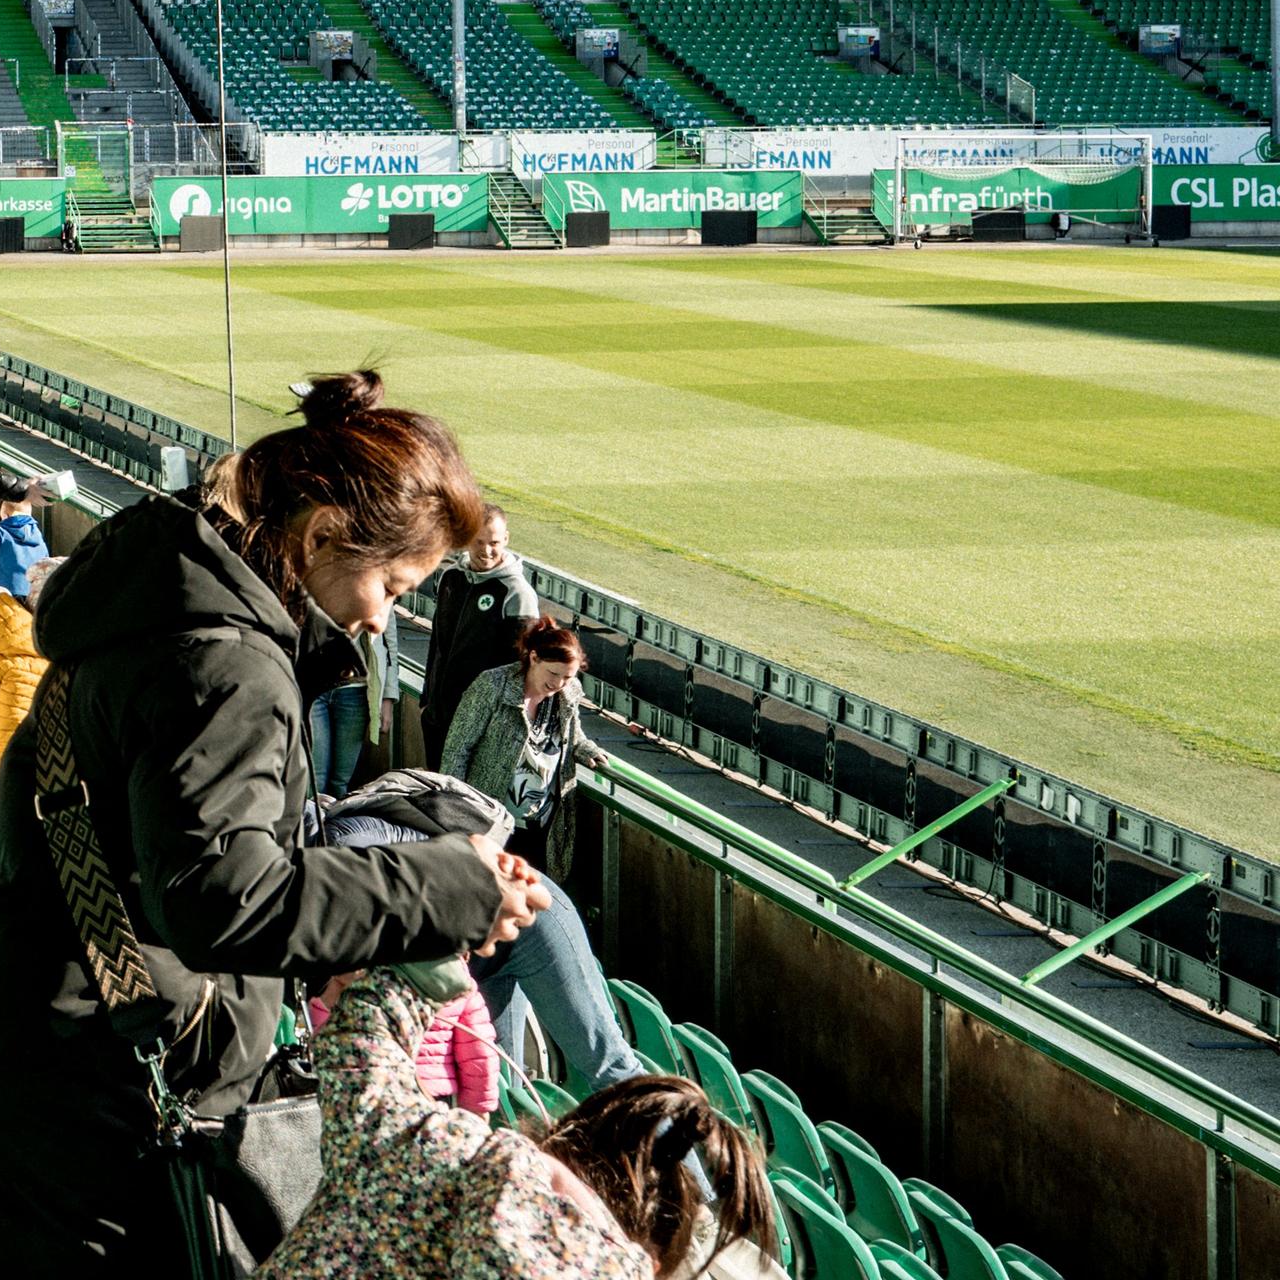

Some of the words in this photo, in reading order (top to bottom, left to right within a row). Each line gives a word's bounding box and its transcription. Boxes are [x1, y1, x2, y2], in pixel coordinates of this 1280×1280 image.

[370, 140, 419, 153] Personal
[587, 138, 634, 149] Personal
[785, 137, 832, 148] Personal
[1162, 132, 1209, 144] Personal
[305, 155, 419, 174] HOFMANN
[522, 152, 635, 171] HOFMANN
[377, 184, 465, 209] LOTTO
[620, 186, 784, 213] MartinBauer
[1170, 177, 1224, 208] CSL
